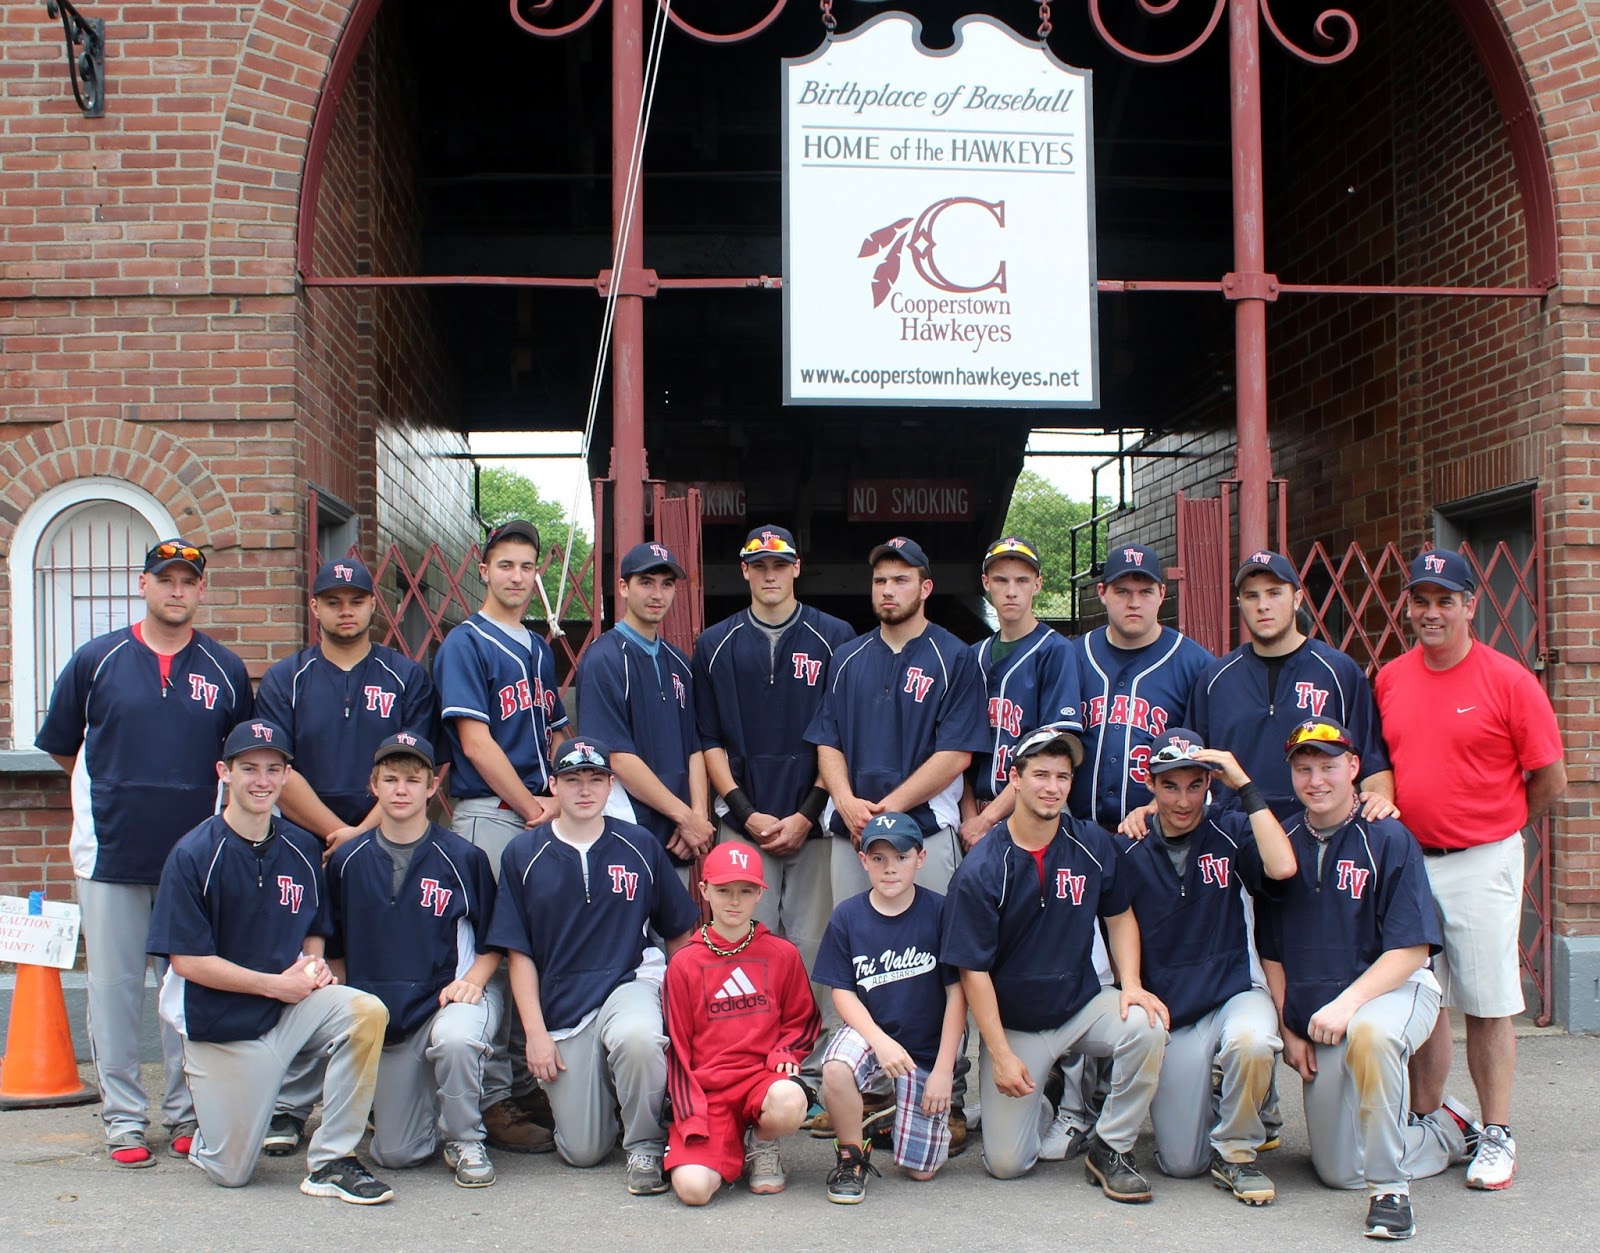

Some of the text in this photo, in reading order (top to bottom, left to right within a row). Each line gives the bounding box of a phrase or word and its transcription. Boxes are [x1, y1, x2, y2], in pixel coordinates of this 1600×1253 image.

[797, 80, 1075, 116] Birthplace of Baseball
[803, 135, 1074, 166] HOME of the HAWKEYES
[890, 292, 1012, 321] Cooperstown
[899, 316, 1012, 353] Hawkeyes
[800, 366, 1080, 390] www.cooperstownhawkeyes.net
[853, 487, 969, 515] NO SMOKING
[650, 543, 668, 561] TV
[1124, 547, 1144, 566] TV
[1252, 552, 1271, 565] TV
[1424, 554, 1446, 574] TV
[334, 564, 354, 582] TV
[792, 652, 823, 686] TV
[188, 673, 220, 710] TV
[904, 666, 935, 703] TV
[1294, 681, 1329, 717] TV
[364, 685, 397, 718] TV
[252, 723, 273, 743] TV
[397, 732, 417, 747] TV
[876, 814, 898, 830] TV
[728, 850, 749, 869] TV
[1198, 853, 1230, 889] TV
[607, 864, 639, 901] TV
[1055, 868, 1087, 906] TV
[1336, 859, 1370, 899] TV
[277, 875, 304, 914] TV
[420, 877, 453, 917] TV
[0, 914, 52, 929] CAUTION
[852, 943, 937, 980] Tri Valley
[872, 969, 916, 986] ALL STARS
[709, 994, 768, 1014] adidas
